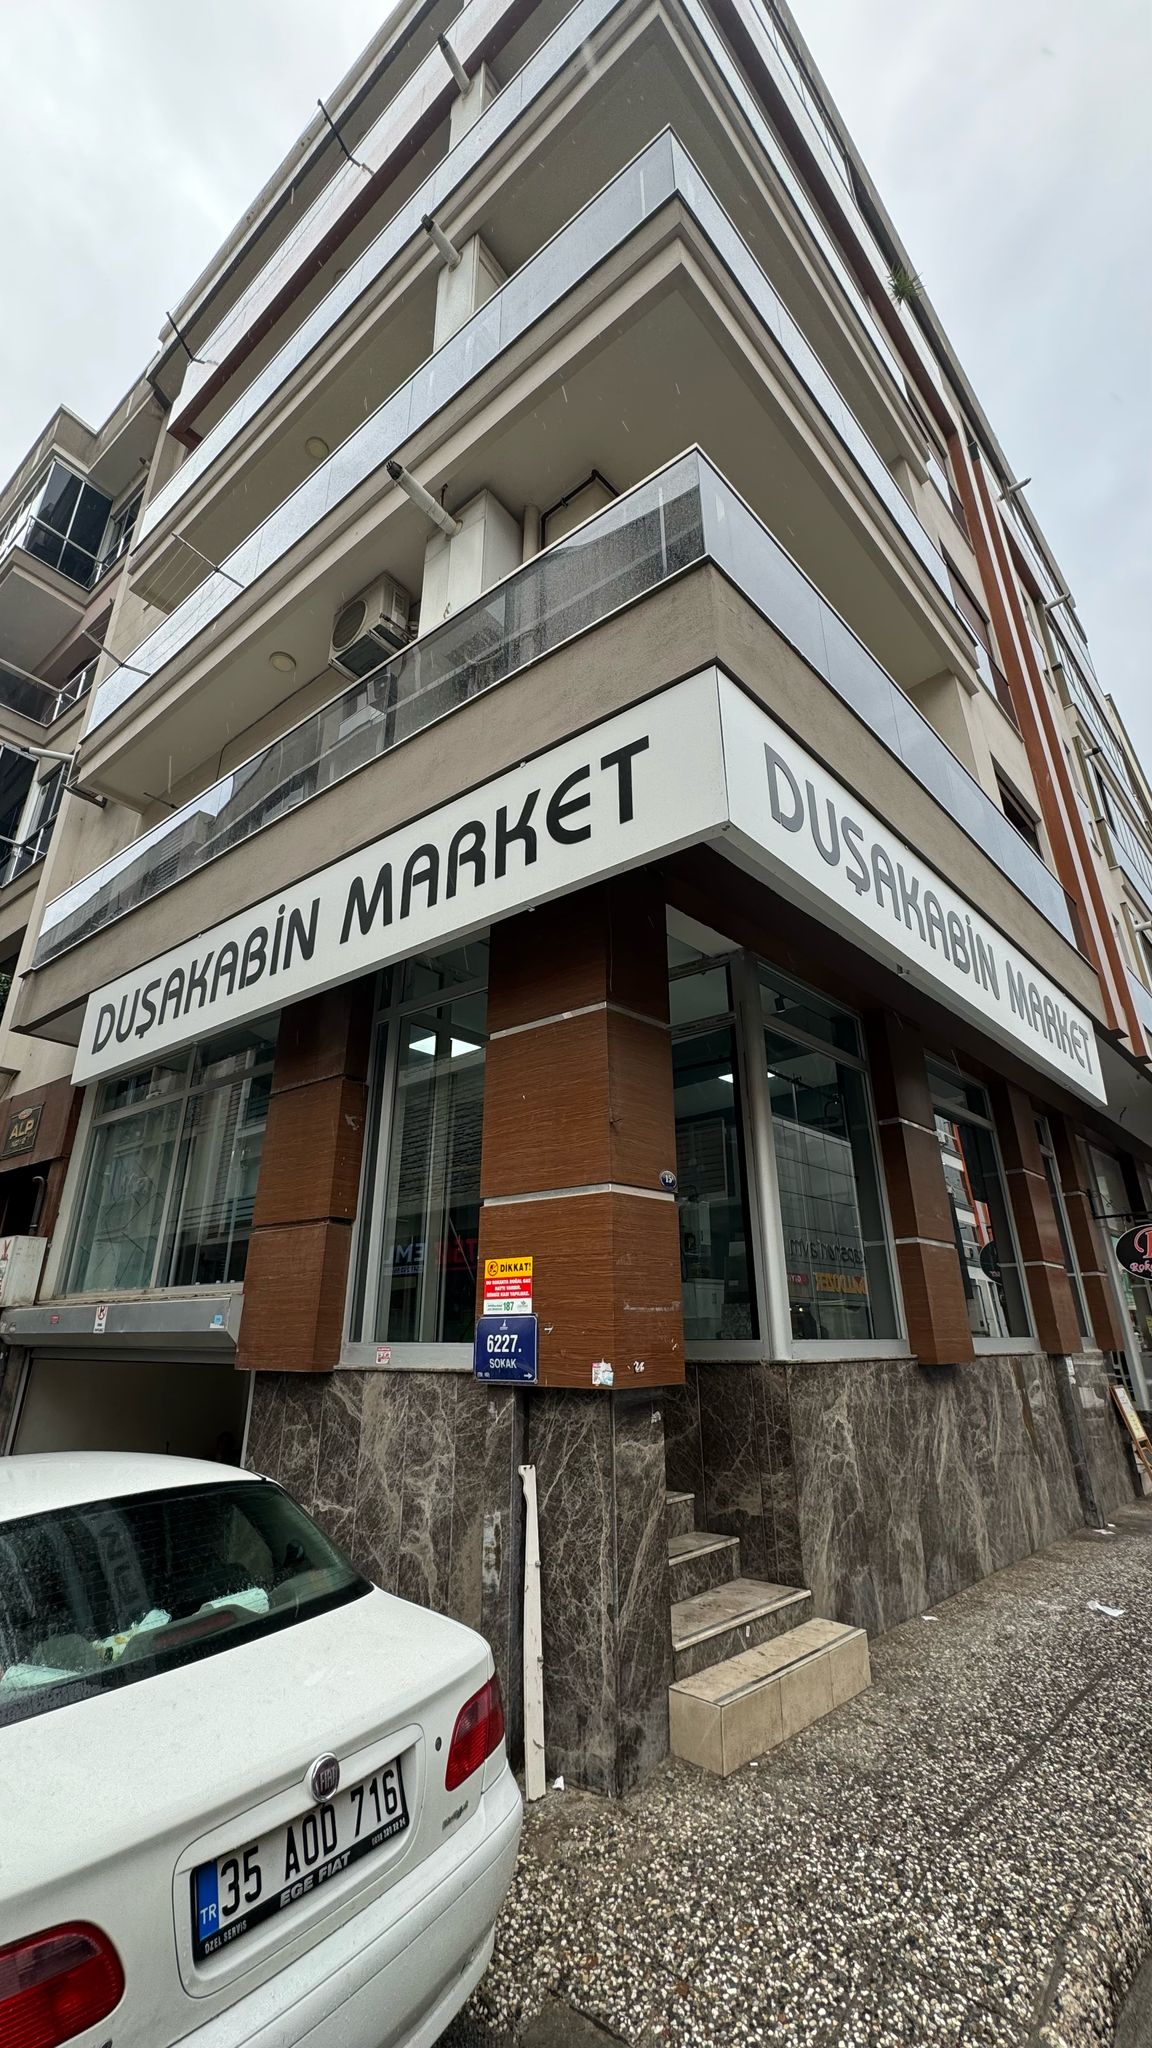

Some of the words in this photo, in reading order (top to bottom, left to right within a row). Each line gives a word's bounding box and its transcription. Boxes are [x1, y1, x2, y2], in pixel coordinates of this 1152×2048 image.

[91, 897, 321, 1055] DUŞAKABİN
[339, 735, 650, 945] MARKET
[763, 742, 1001, 1001] DUŞAKABİN
[1005, 959, 1093, 1075] MARKET
[500, 1262, 532, 1272] DİKKAT!
[503, 1301, 515, 1311] 187
[486, 1334, 522, 1353] 6227.
[489, 1358, 517, 1369] SOKAK
[320, 1766, 336, 1793] FIAT
[200, 1903, 217, 1925] TR
[220, 1845, 262, 1917] 35
[284, 1803, 338, 1882] AOD
[350, 1768, 398, 1838] 716
[279, 1875, 313, 1909] EGE
[318, 1851, 351, 1882] FIAT
